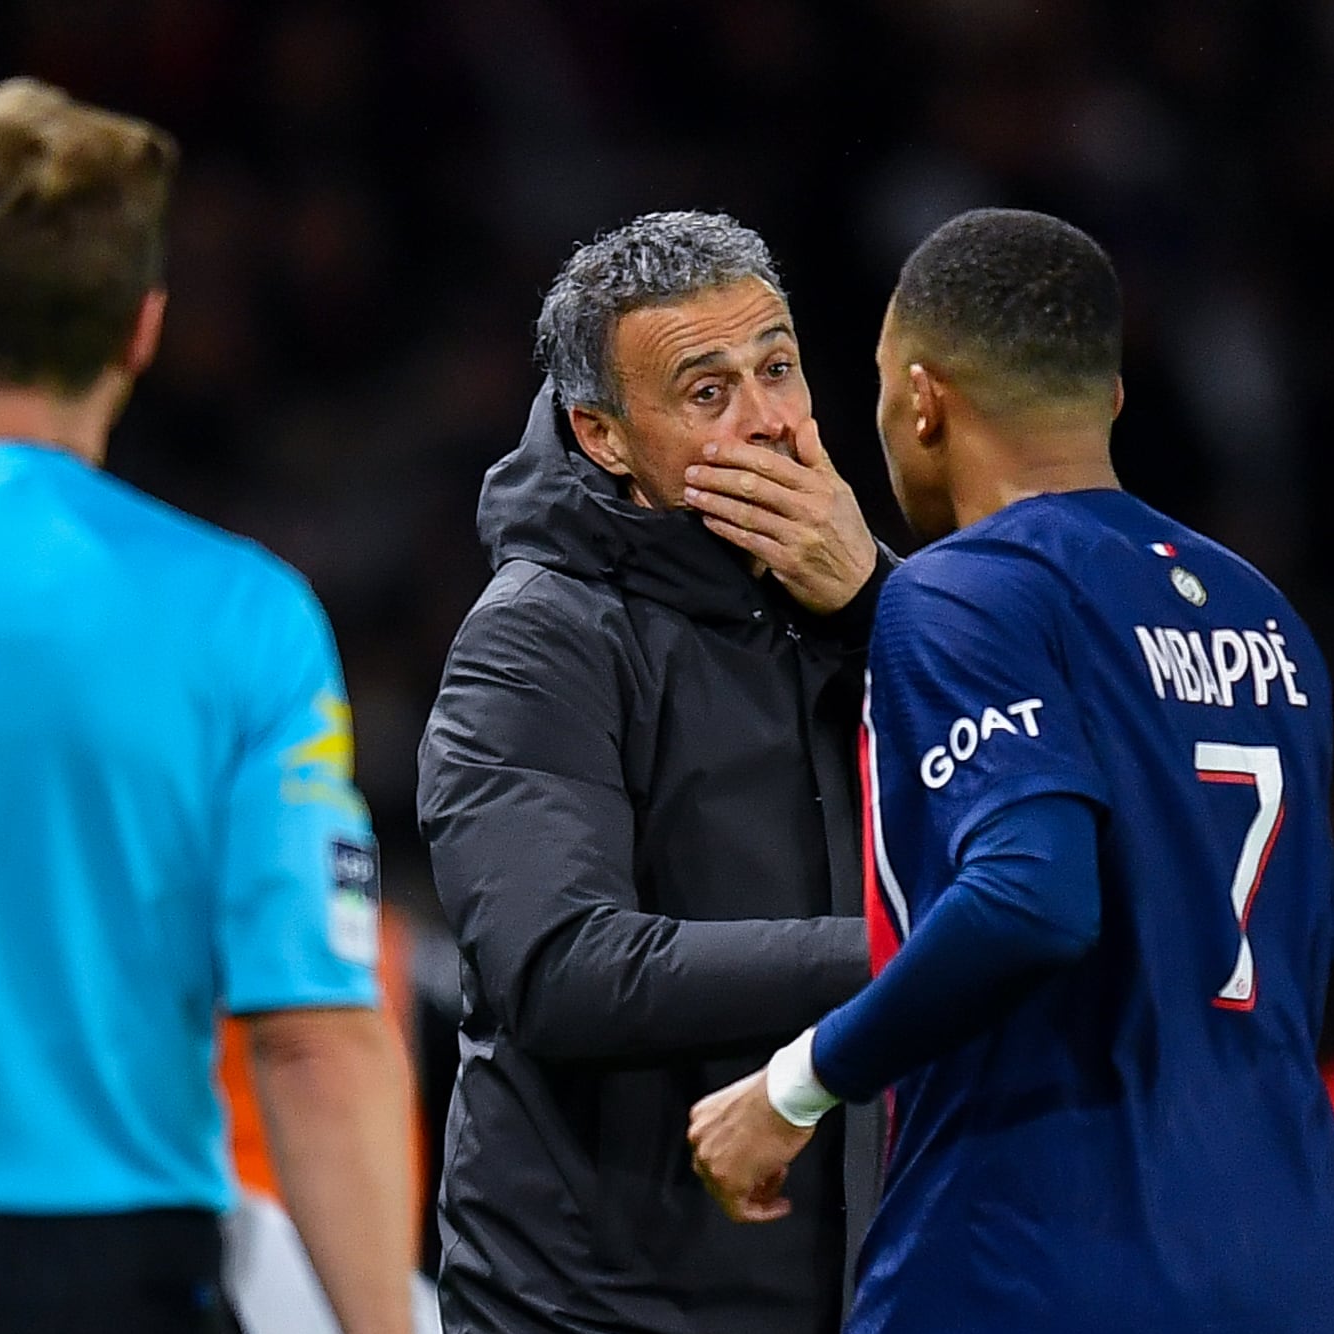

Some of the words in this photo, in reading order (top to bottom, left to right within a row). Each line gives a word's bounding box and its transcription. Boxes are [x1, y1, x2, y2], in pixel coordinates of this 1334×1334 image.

[1135, 618, 1308, 708] MBAPPÉ
[921, 698, 1044, 789] GOAT
[1194, 742, 1285, 1011] 7
